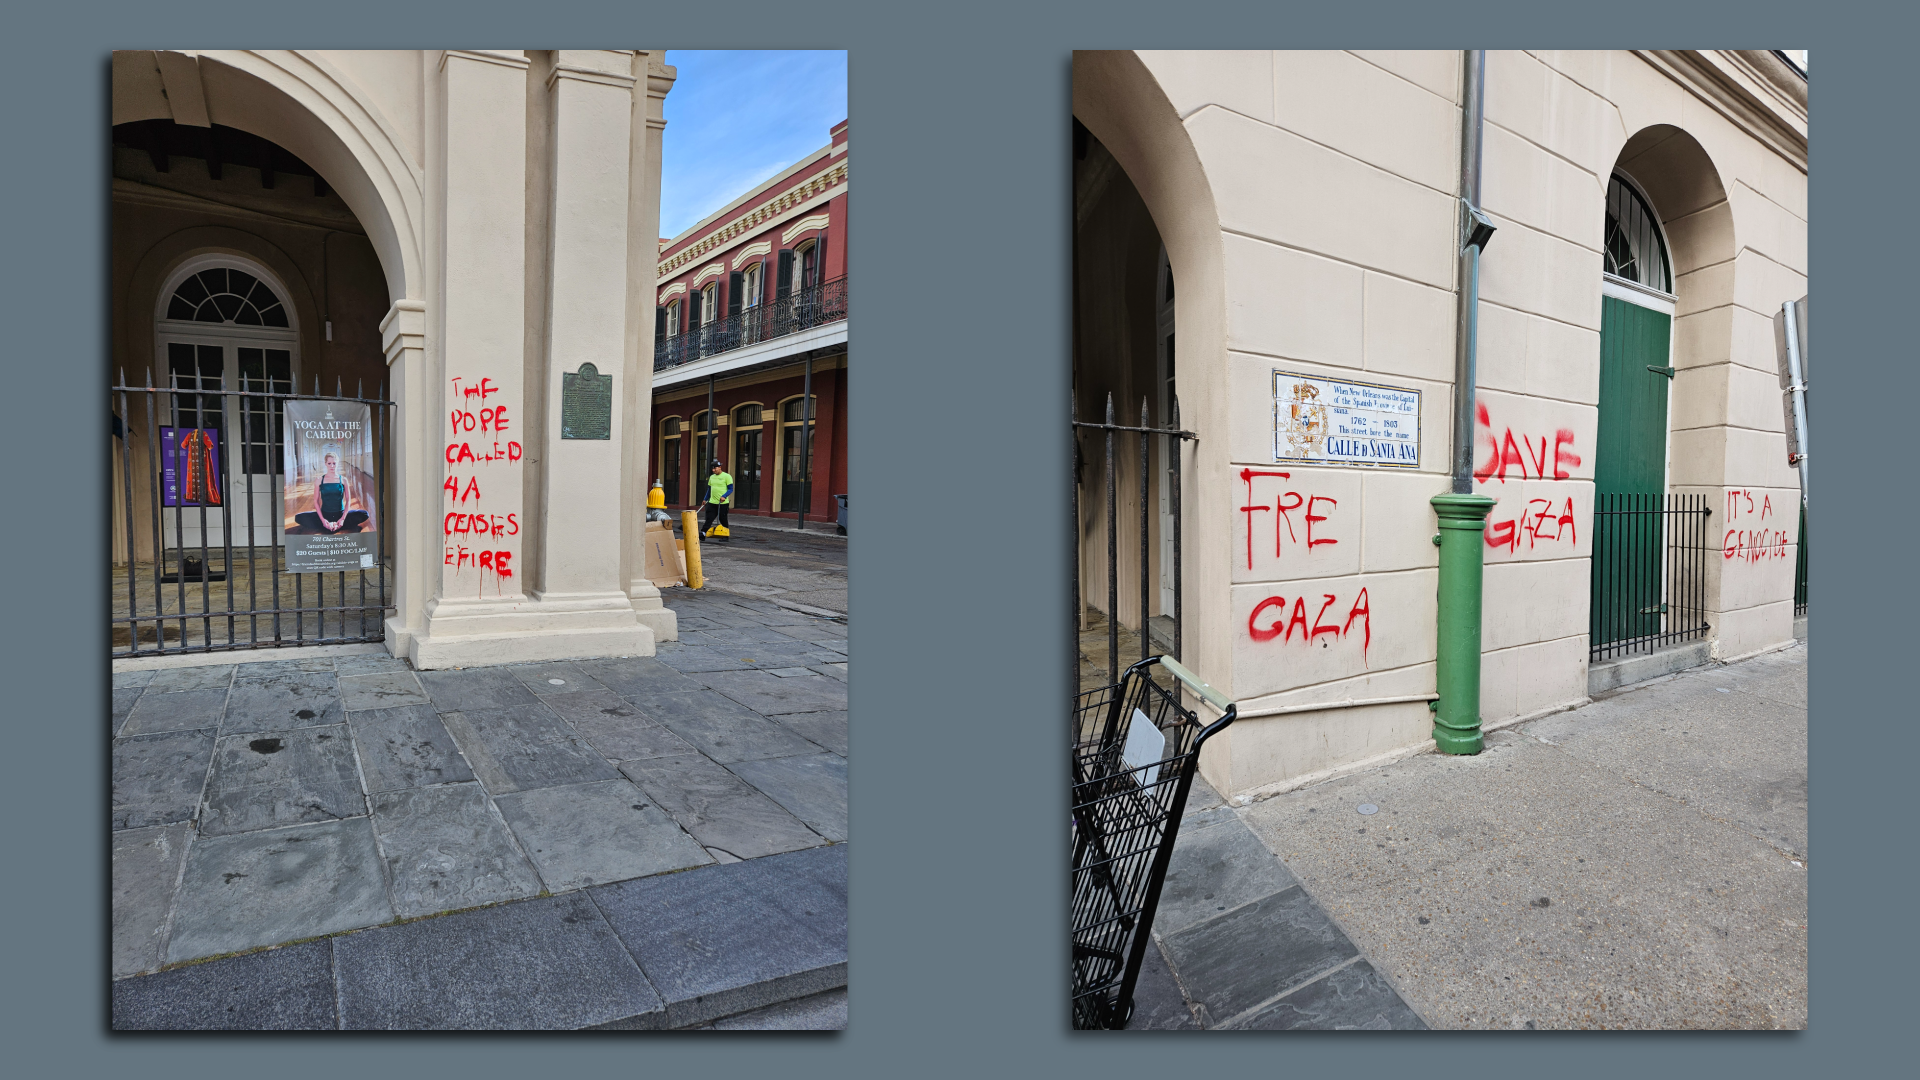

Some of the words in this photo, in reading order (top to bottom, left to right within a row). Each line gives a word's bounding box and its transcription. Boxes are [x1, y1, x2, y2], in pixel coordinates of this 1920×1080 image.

[451, 377, 498, 398] THE
[1334, 386, 1348, 396] When
[1349, 388, 1360, 396] New
[1362, 389, 1381, 399] Orleans
[1391, 393, 1399, 401] the
[1400, 394, 1415, 404] Capital
[1334, 396, 1340, 404] of
[1342, 397, 1351, 405] the
[1353, 397, 1373, 408] Spanish
[294, 421, 324, 430] YOGA
[326, 421, 341, 430] AT
[342, 421, 361, 430] THE
[451, 406, 509, 433] POPE
[1339, 425, 1349, 434] This
[1351, 427, 1367, 435] street
[1370, 428, 1381, 436] bore
[1384, 429, 1392, 437] the
[1351, 417, 1367, 426] 1762
[1383, 420, 1398, 429] 1803
[305, 430, 352, 439] CABILDO
[1474, 401, 1581, 484] SAVE
[446, 441, 522, 463] CALLED
[1327, 436, 1360, 456] CALLE
[1370, 439, 1395, 458] SANTA
[1398, 442, 1416, 460] ANA
[1727, 489, 1754, 523] IT'S
[1761, 494, 1772, 521] A
[1240, 468, 1338, 570] FRE
[1484, 497, 1576, 555] GAZA
[1722, 528, 1788, 565] GENOCIDE
[444, 546, 513, 577] EFIRE
[1249, 587, 1370, 652] GAZA
